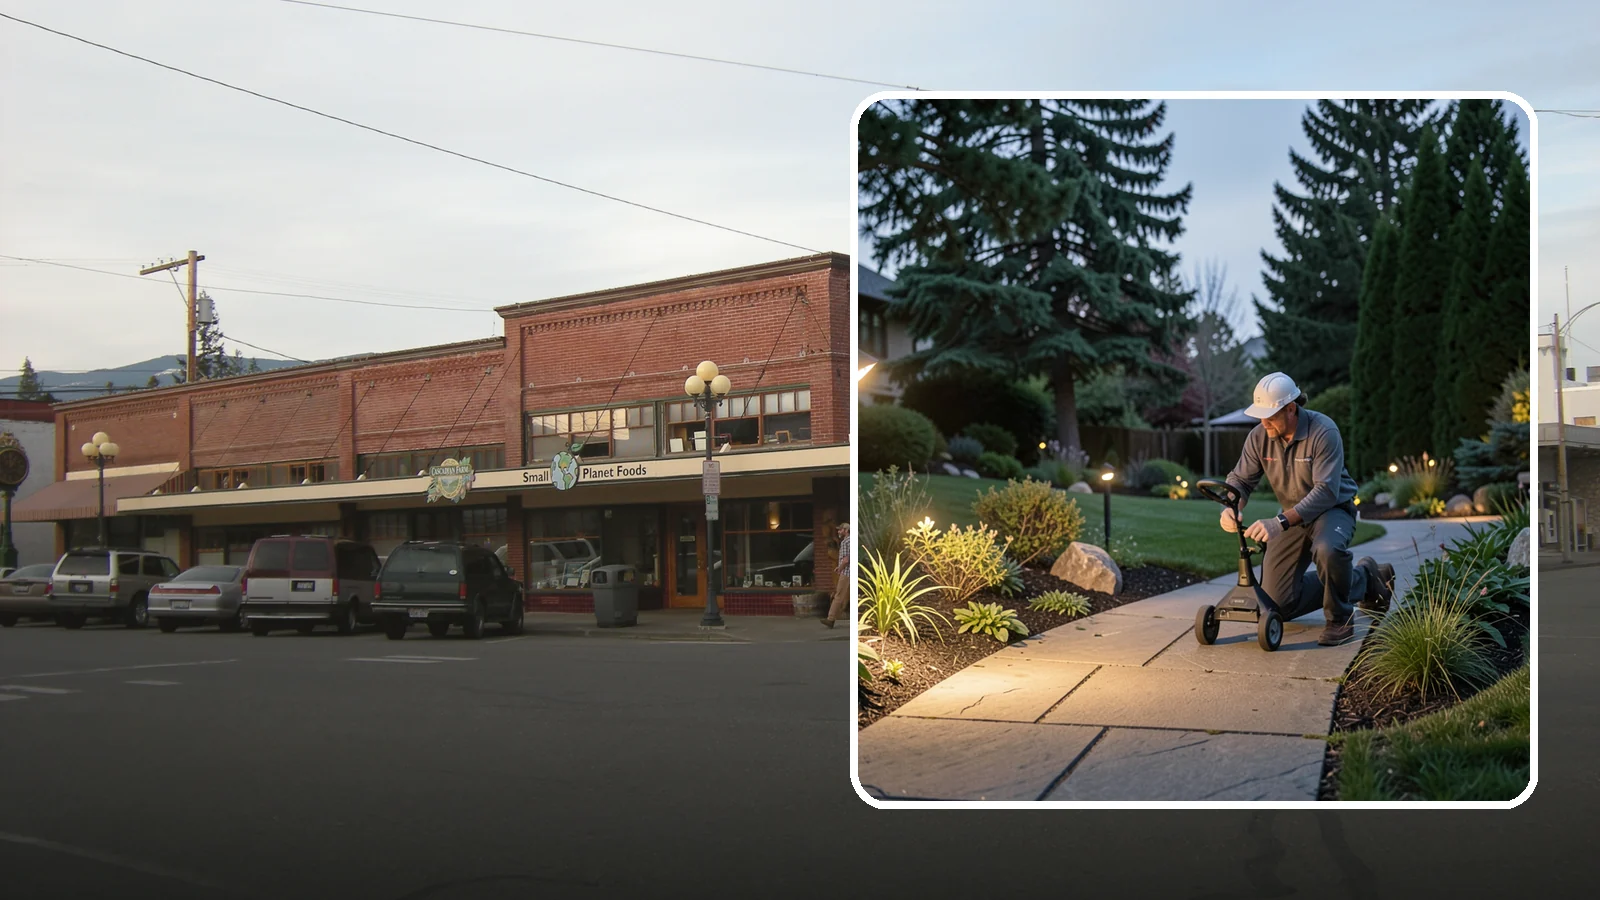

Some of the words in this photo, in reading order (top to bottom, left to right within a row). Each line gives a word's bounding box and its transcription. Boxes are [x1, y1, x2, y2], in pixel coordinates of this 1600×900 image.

[523, 471, 549, 483] Small
[583, 466, 614, 479] Planet
[617, 464, 647, 477] Foods
